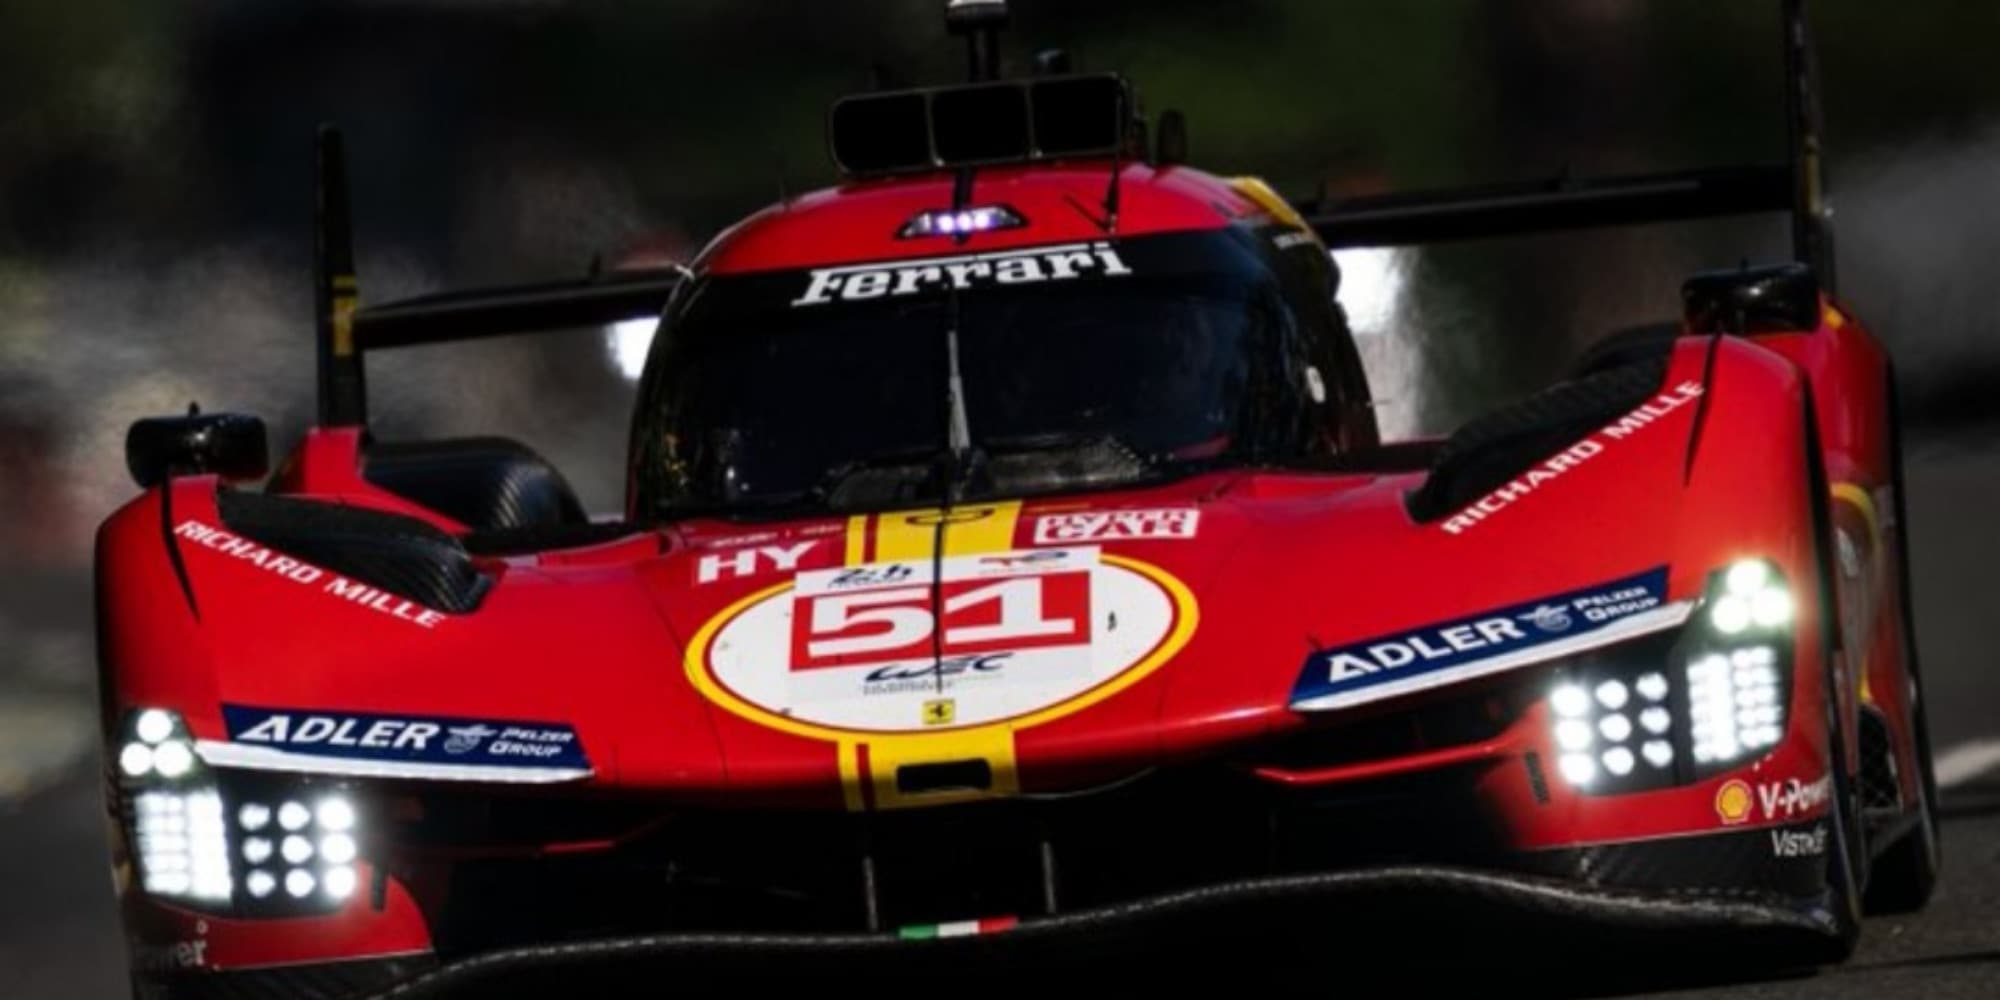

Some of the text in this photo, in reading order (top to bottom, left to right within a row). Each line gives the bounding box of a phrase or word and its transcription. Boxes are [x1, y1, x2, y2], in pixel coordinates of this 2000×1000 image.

[791, 241, 1132, 307] Ferrari
[1440, 380, 1705, 535] RICHARD MILLE
[173, 519, 446, 628] RICHARD MILLE
[698, 540, 820, 584] HY
[806, 575, 1075, 659] 51
[1583, 596, 1660, 623] GROUP
[1326, 615, 1527, 684] ADLER
[236, 715, 441, 750] ADLER
[487, 739, 563, 758] GROUP
